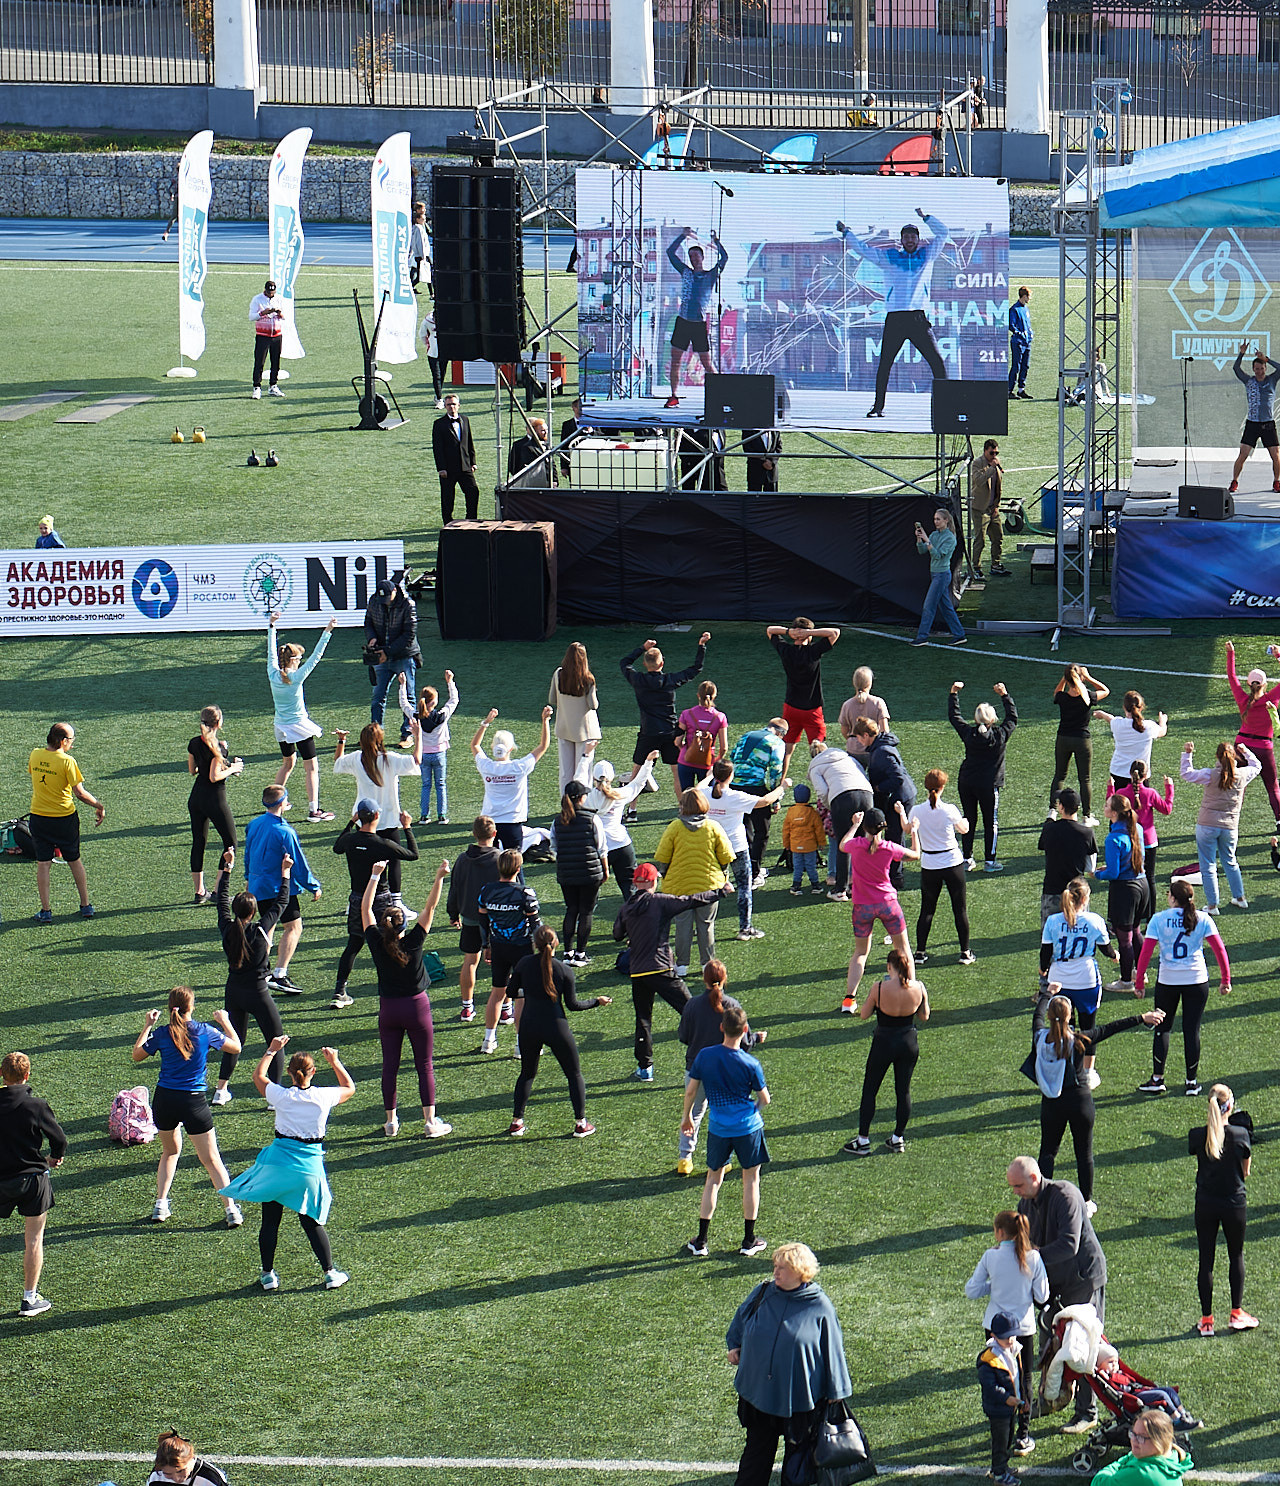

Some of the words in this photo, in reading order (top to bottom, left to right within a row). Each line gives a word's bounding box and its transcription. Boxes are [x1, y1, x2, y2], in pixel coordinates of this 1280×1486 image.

[398, 224, 410, 298] ПЕРВЫХ
[955, 272, 1007, 288] СИЛА
[6, 559, 125, 584] АКАДЕМИЯ
[193, 573, 217, 586] ЧМЗ
[7, 584, 125, 609] ЗДОРОВЬЯ
[193, 592, 237, 602] РОСАТОМ
[3, 614, 47, 623] ПРЕСТИЖНО!
[1056, 936, 1089, 962] 10
[1172, 931, 1188, 959] 6
